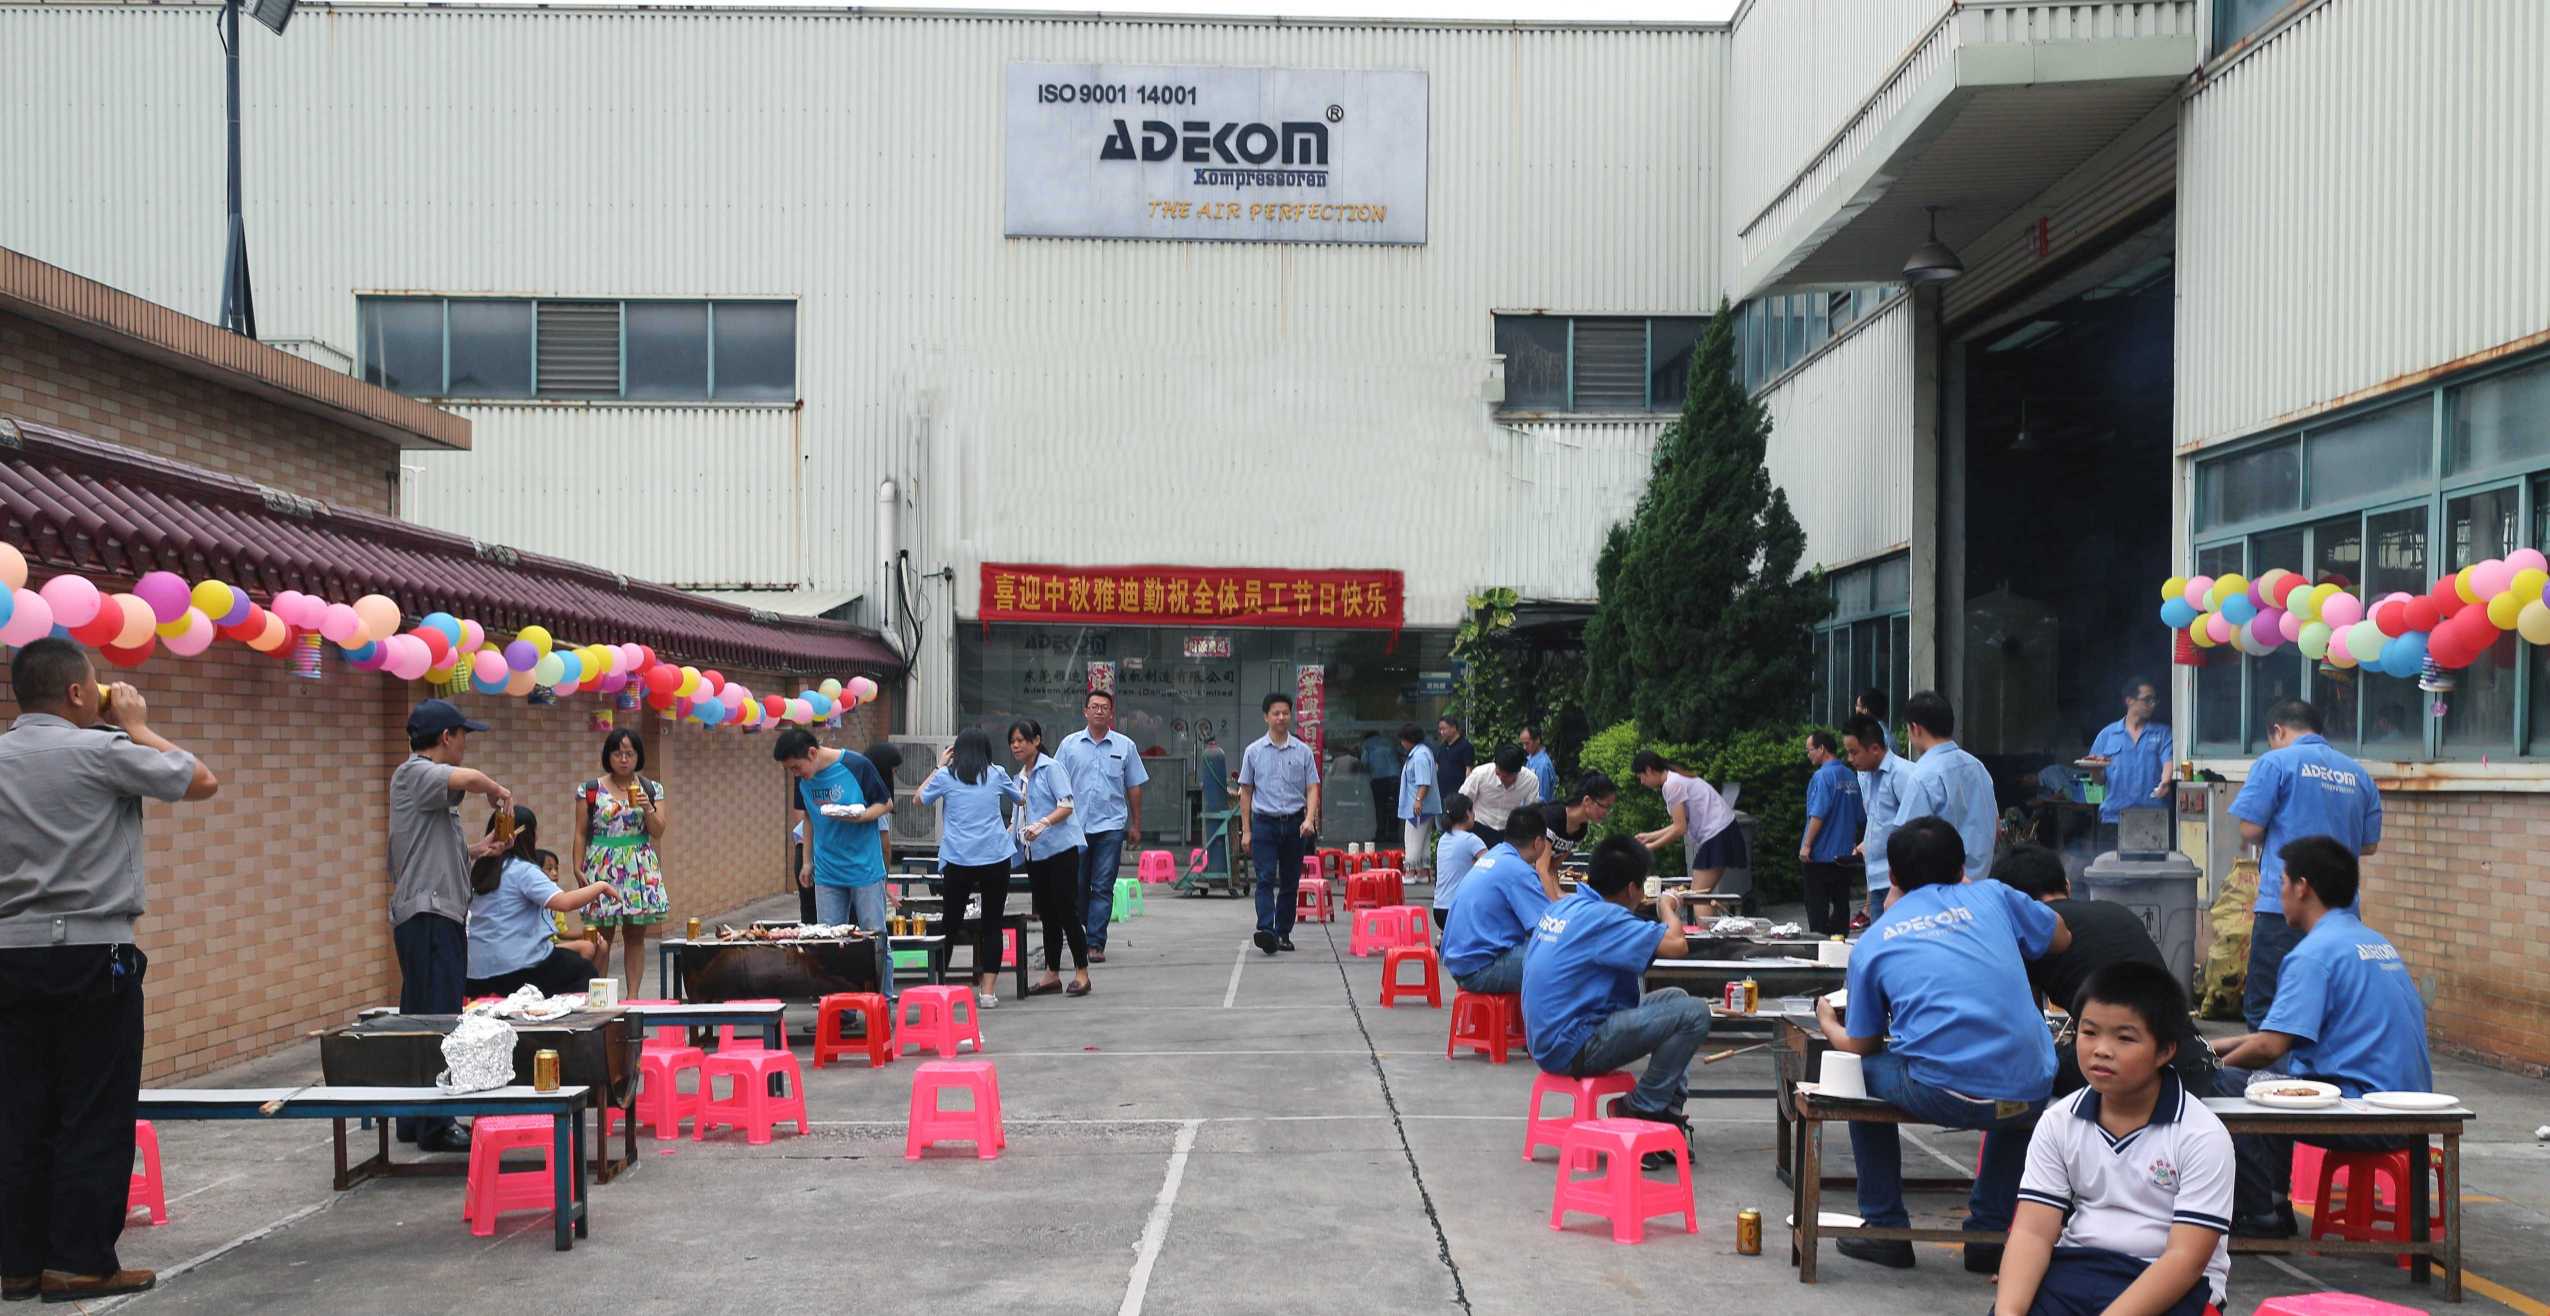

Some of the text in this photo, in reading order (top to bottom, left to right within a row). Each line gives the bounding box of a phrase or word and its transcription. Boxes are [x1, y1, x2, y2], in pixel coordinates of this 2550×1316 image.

[1038, 84, 1197, 105] ISO 9001 14001
[1100, 118, 1329, 165] ADEKOM
[1193, 168, 1328, 190] Kompressoren
[1148, 201, 1388, 223] THE AIR PERFECTION
[993, 573, 1387, 617] 喜迎中秋雅迪勤祝全体员工节日快乐
[2300, 763, 2357, 787] ADEKOM
